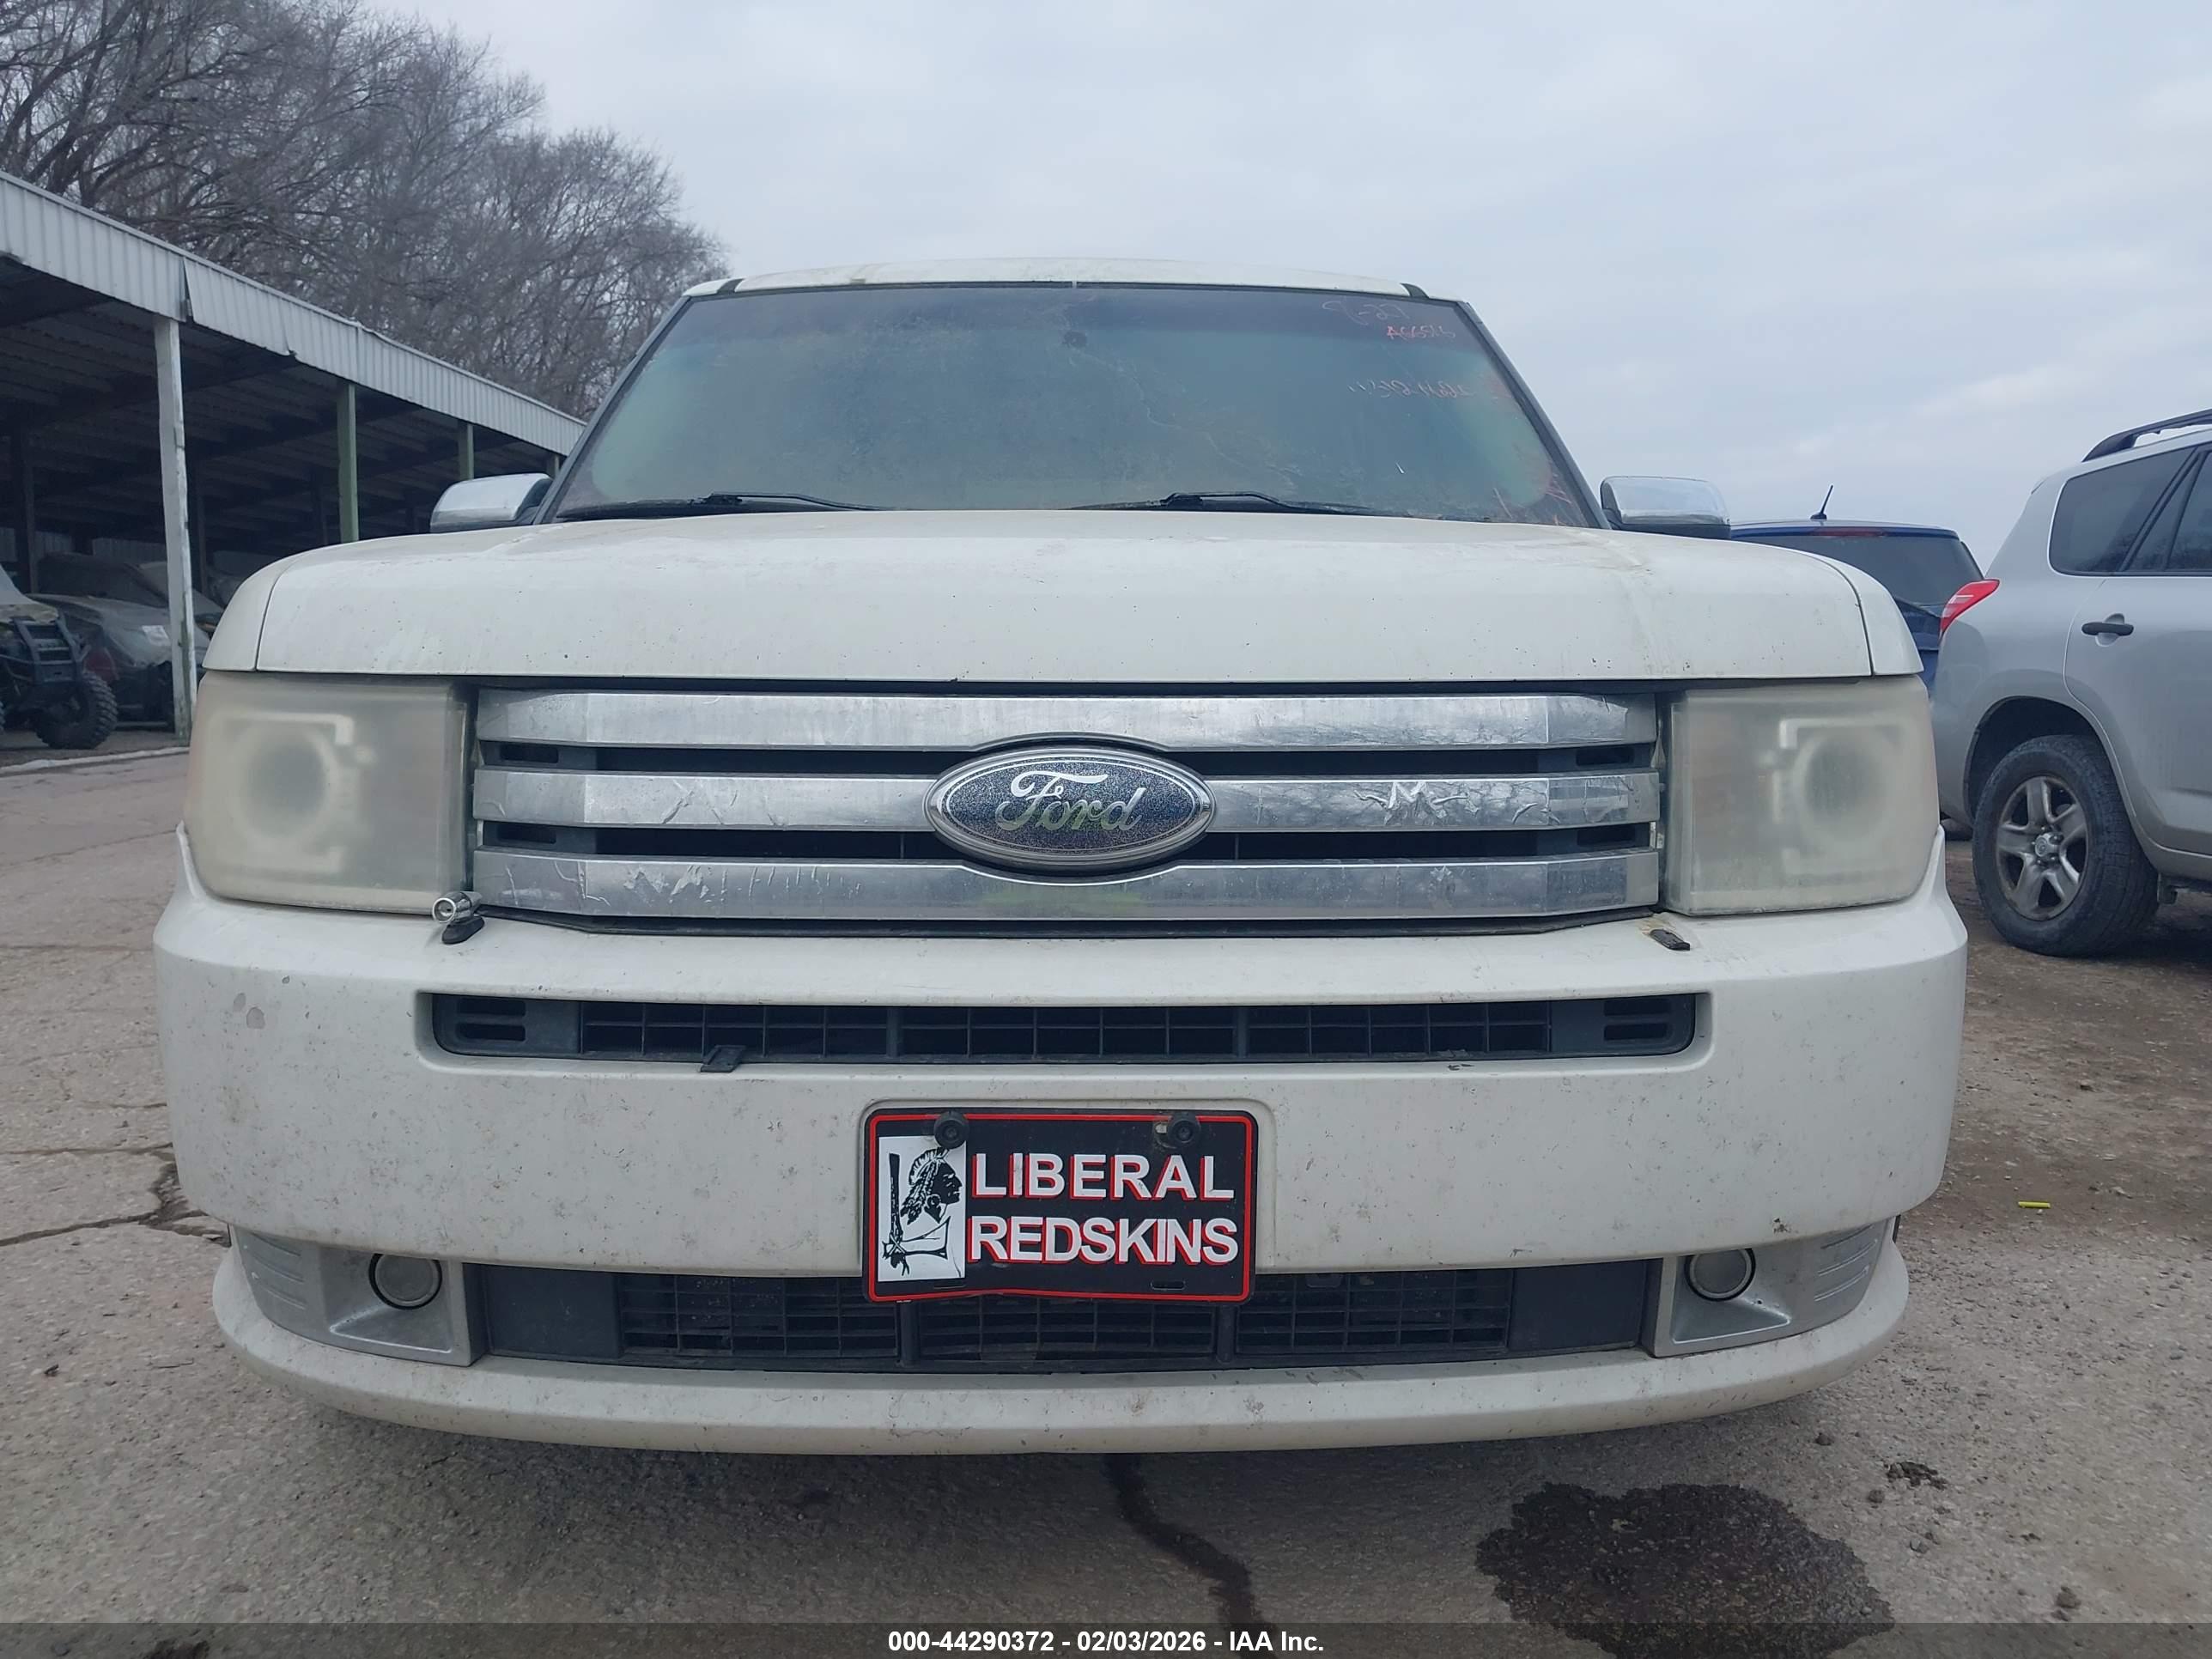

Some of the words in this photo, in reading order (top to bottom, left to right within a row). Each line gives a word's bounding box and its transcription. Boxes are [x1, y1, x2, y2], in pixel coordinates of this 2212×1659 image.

[994, 770, 1146, 831] Ford
[971, 1152, 1235, 1200] LIBERAL
[968, 1215, 1239, 1267] REDSKINS
